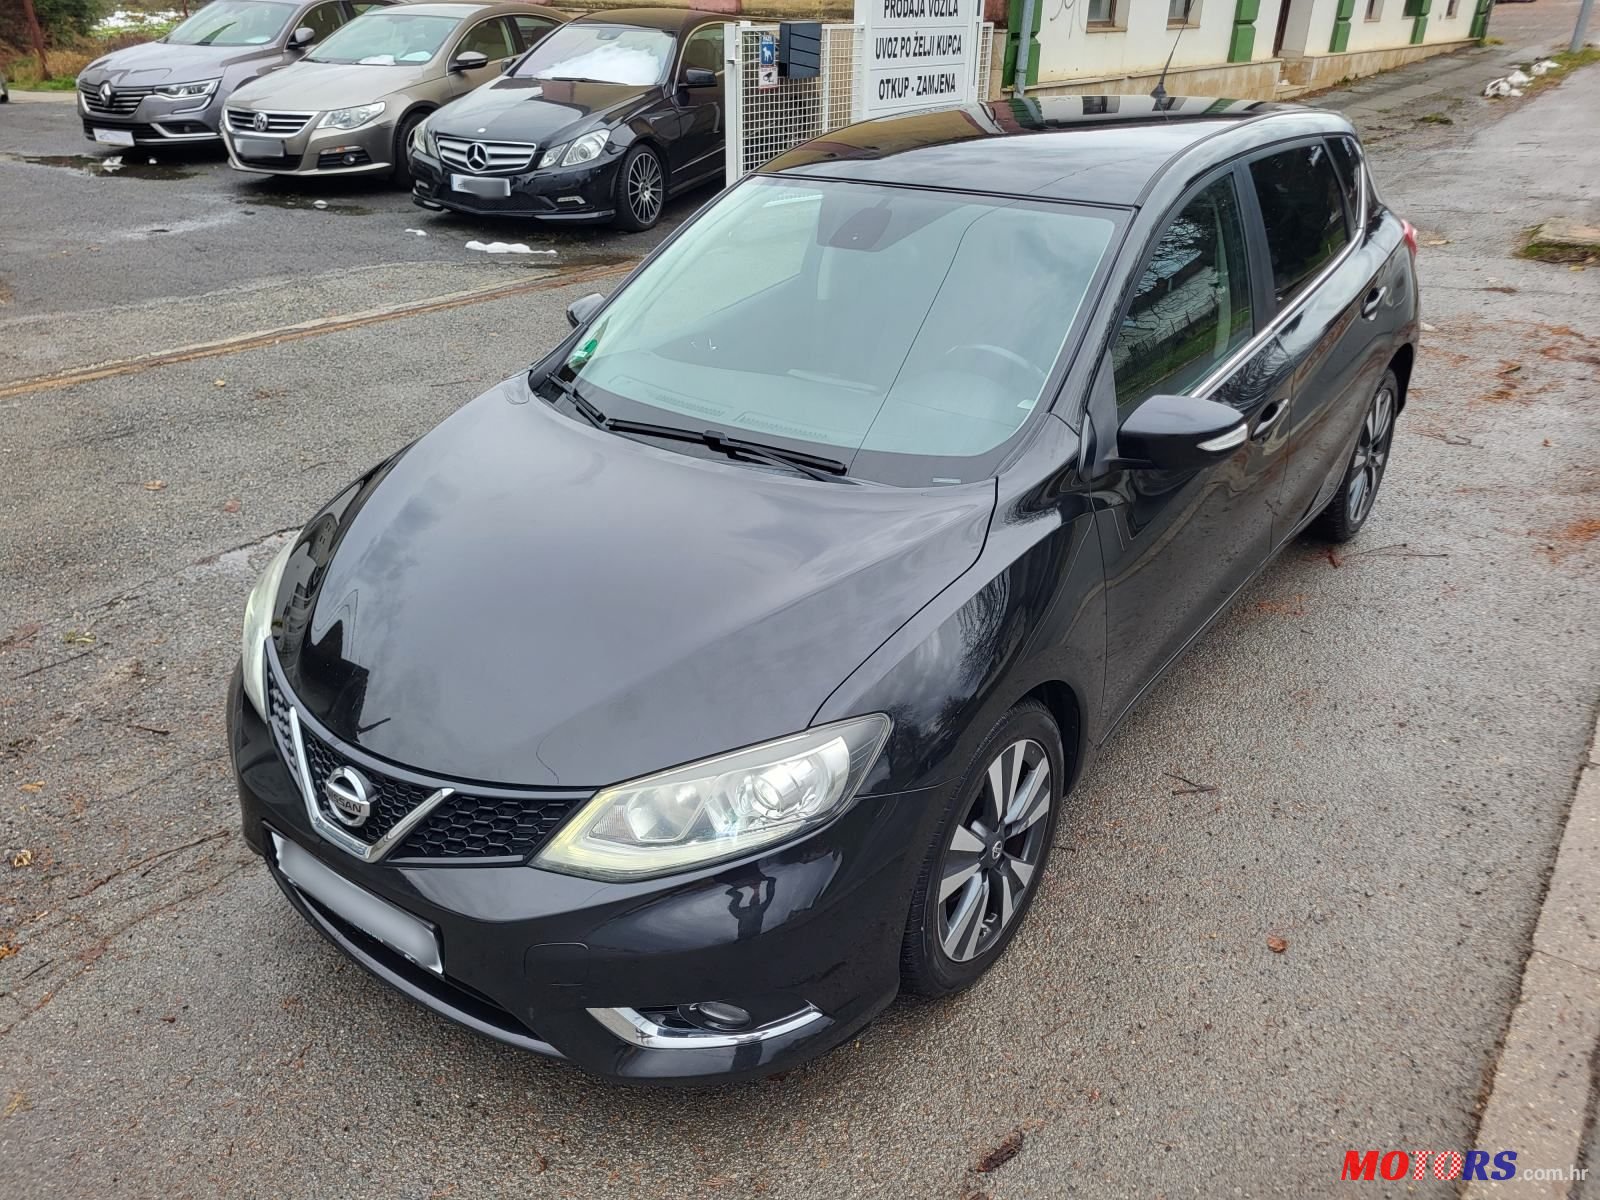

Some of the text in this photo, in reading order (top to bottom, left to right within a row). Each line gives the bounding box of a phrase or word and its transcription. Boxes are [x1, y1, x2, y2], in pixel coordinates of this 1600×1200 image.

[884, 0, 958, 18] PRODAJA VOZILA
[876, 31, 961, 59] UVOZ PO ŽELJI KUPCA
[879, 77, 909, 100] OTKUP
[916, 73, 956, 96] ZAMJENA
